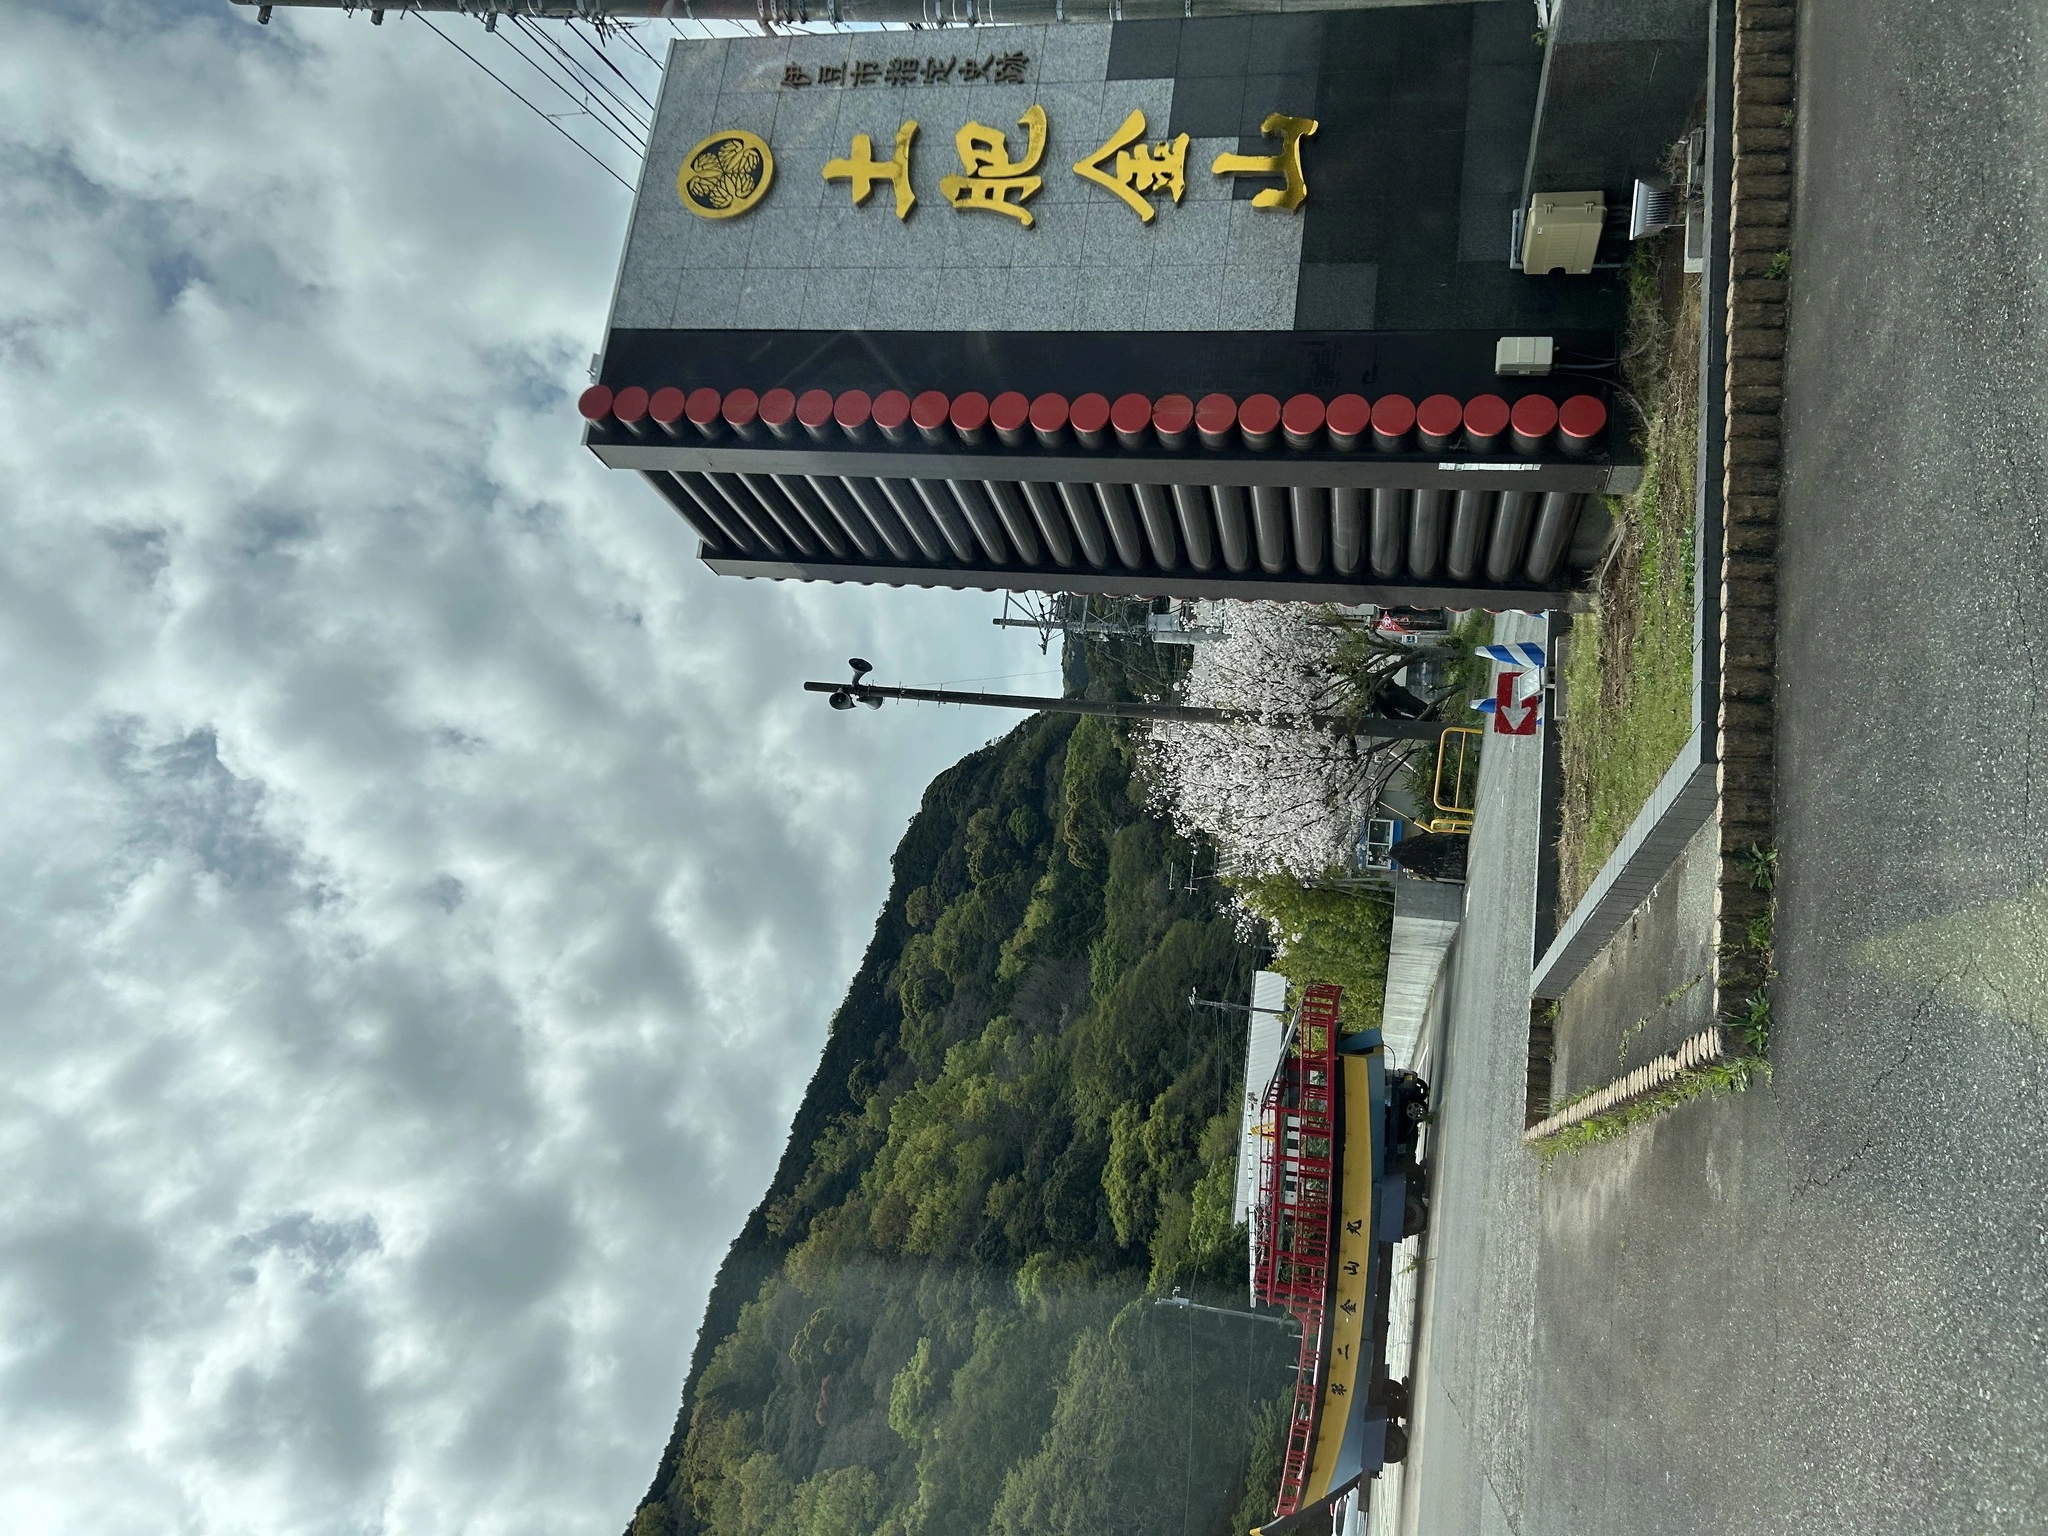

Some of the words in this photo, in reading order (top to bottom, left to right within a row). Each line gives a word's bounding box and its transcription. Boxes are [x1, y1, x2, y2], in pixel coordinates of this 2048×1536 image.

[780, 51, 1030, 89] 伊豆市指定史跡
[821, 104, 1319, 230] 土肥金山
[1330, 1219, 1363, 1396] 第二金山丸
